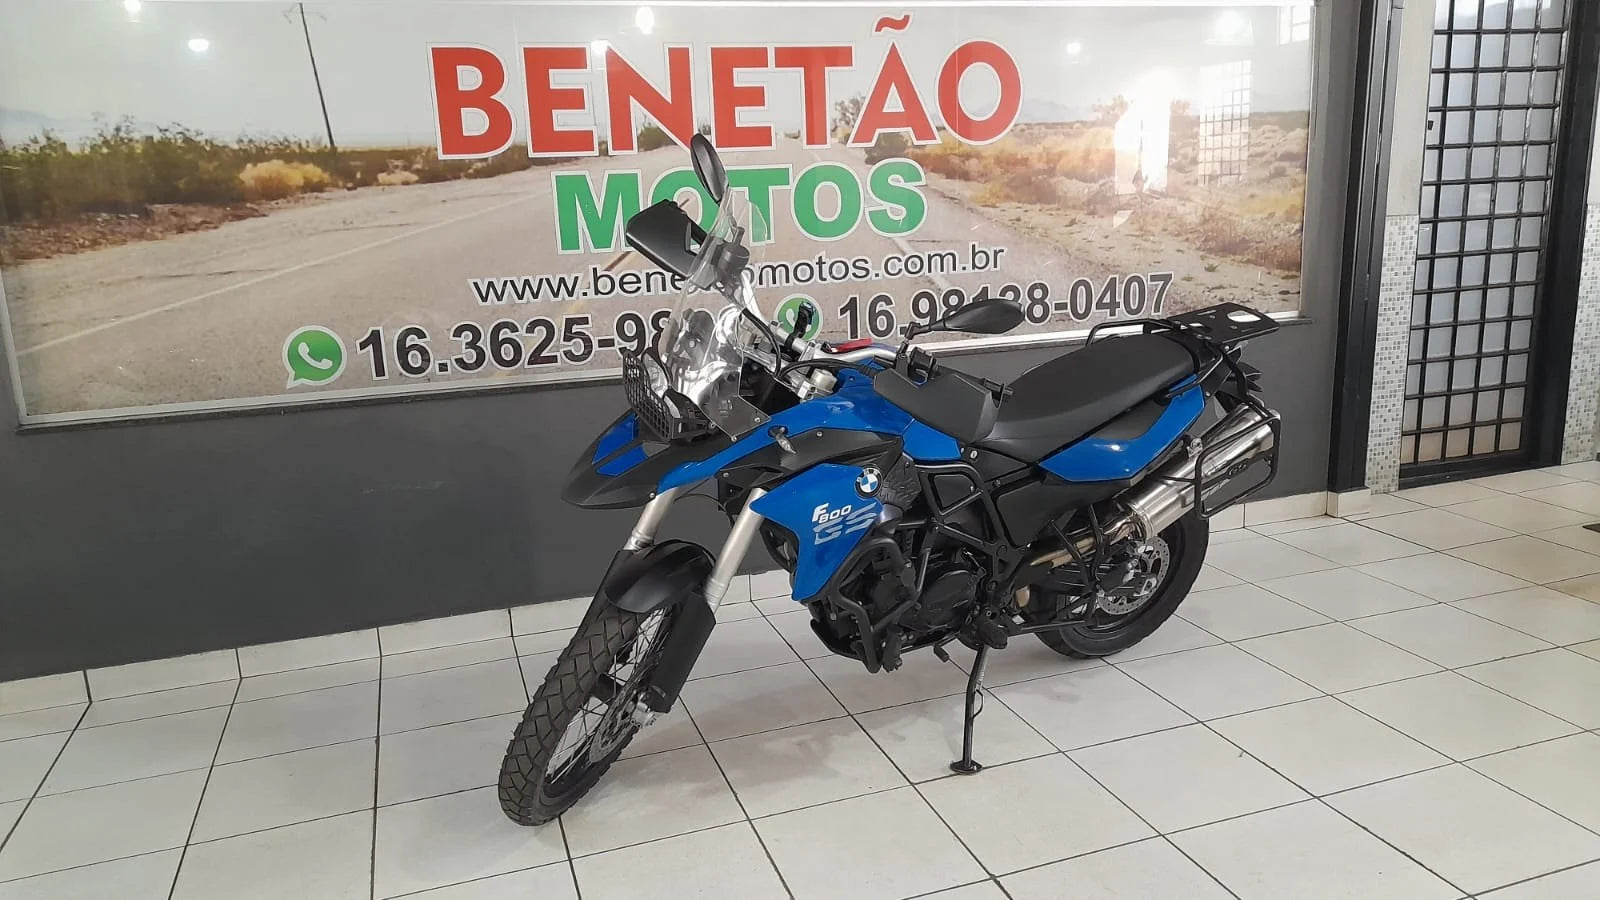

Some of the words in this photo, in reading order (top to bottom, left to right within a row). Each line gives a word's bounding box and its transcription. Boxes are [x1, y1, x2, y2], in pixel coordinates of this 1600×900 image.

[429, 14, 1022, 157] BENETÃO
[554, 160, 927, 251] MOTOS
[813, 502, 877, 545] GS
